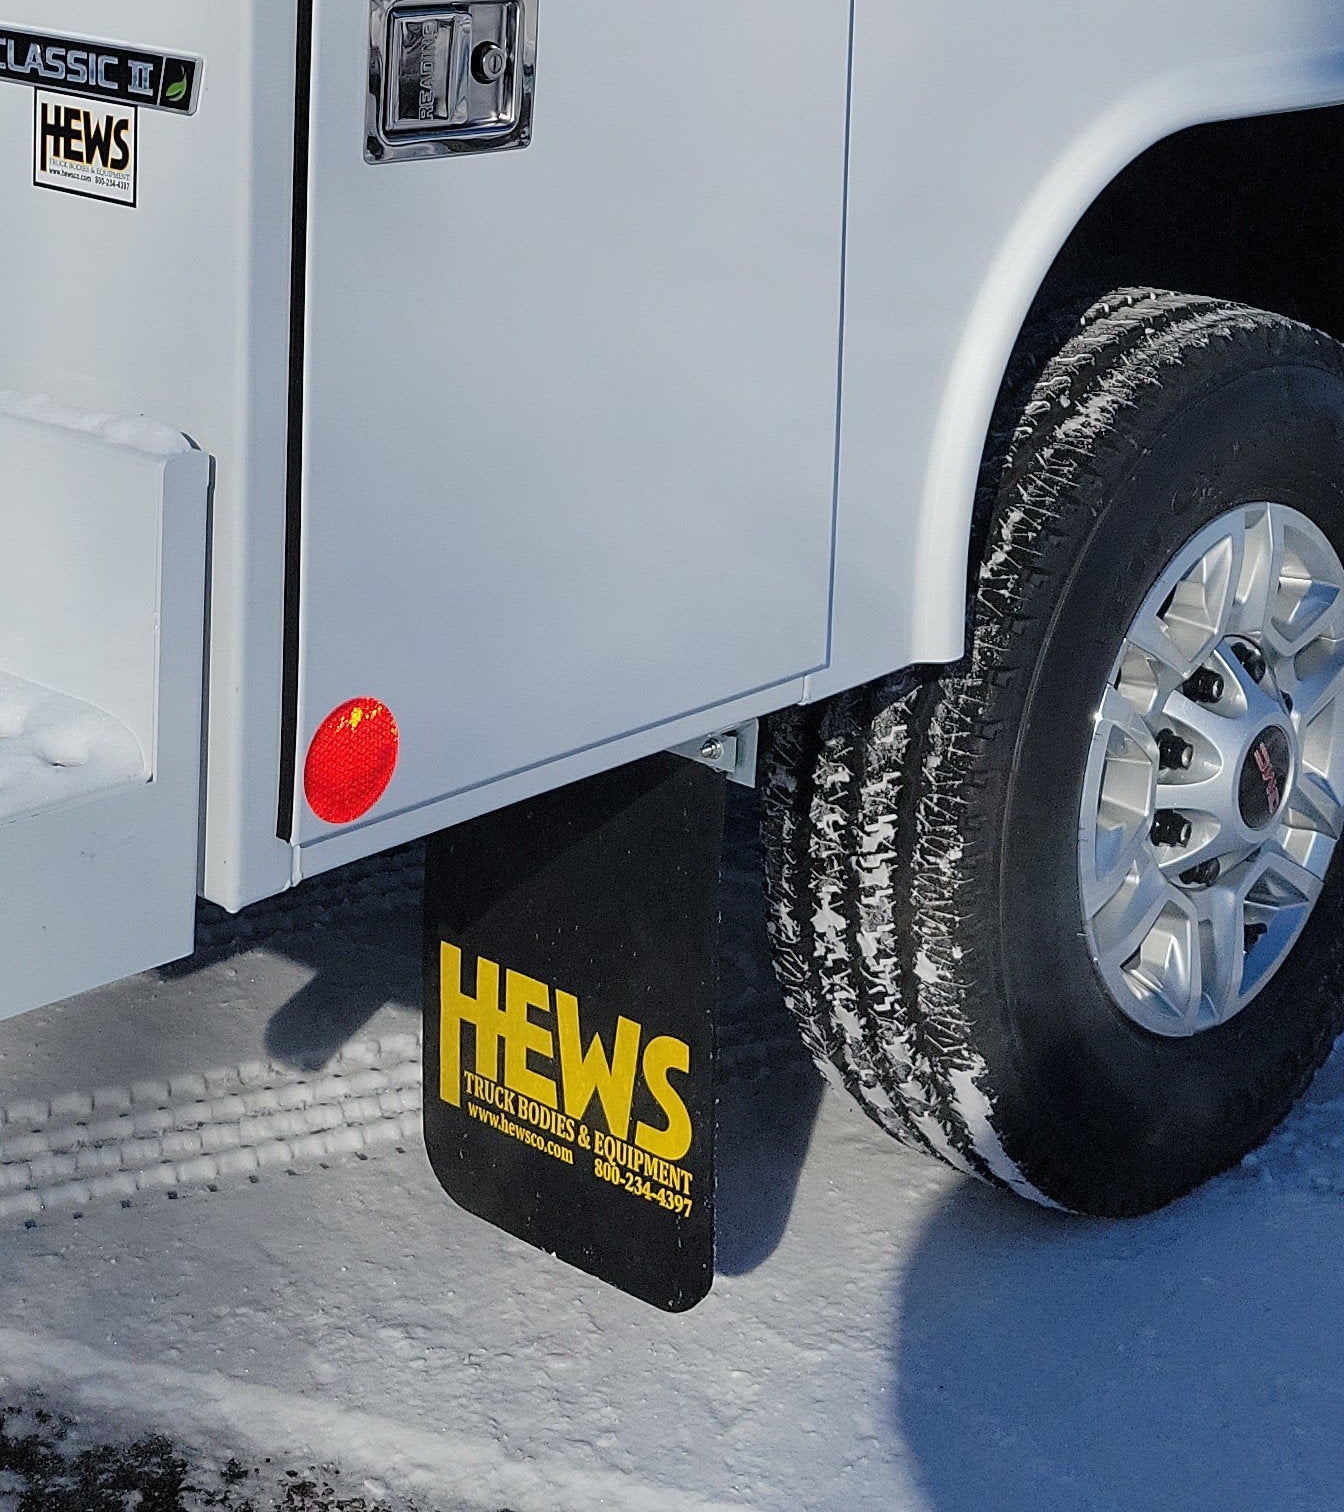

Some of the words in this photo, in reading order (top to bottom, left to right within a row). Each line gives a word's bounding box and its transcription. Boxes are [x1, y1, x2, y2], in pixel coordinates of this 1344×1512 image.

[128, 60, 153, 96] II
[419, 20, 439, 120] READING
[40, 102, 130, 172] HEWS
[440, 940, 693, 1161] HEWS
[464, 1071, 515, 1116] TRUCK
[518, 1094, 575, 1141] BODIES
[577, 1124, 590, 1150] &
[594, 1130, 692, 1196] EQUIPMENT
[468, 1101, 573, 1165] www.hewsco.com
[594, 1158, 692, 1218] 800-234-4397
